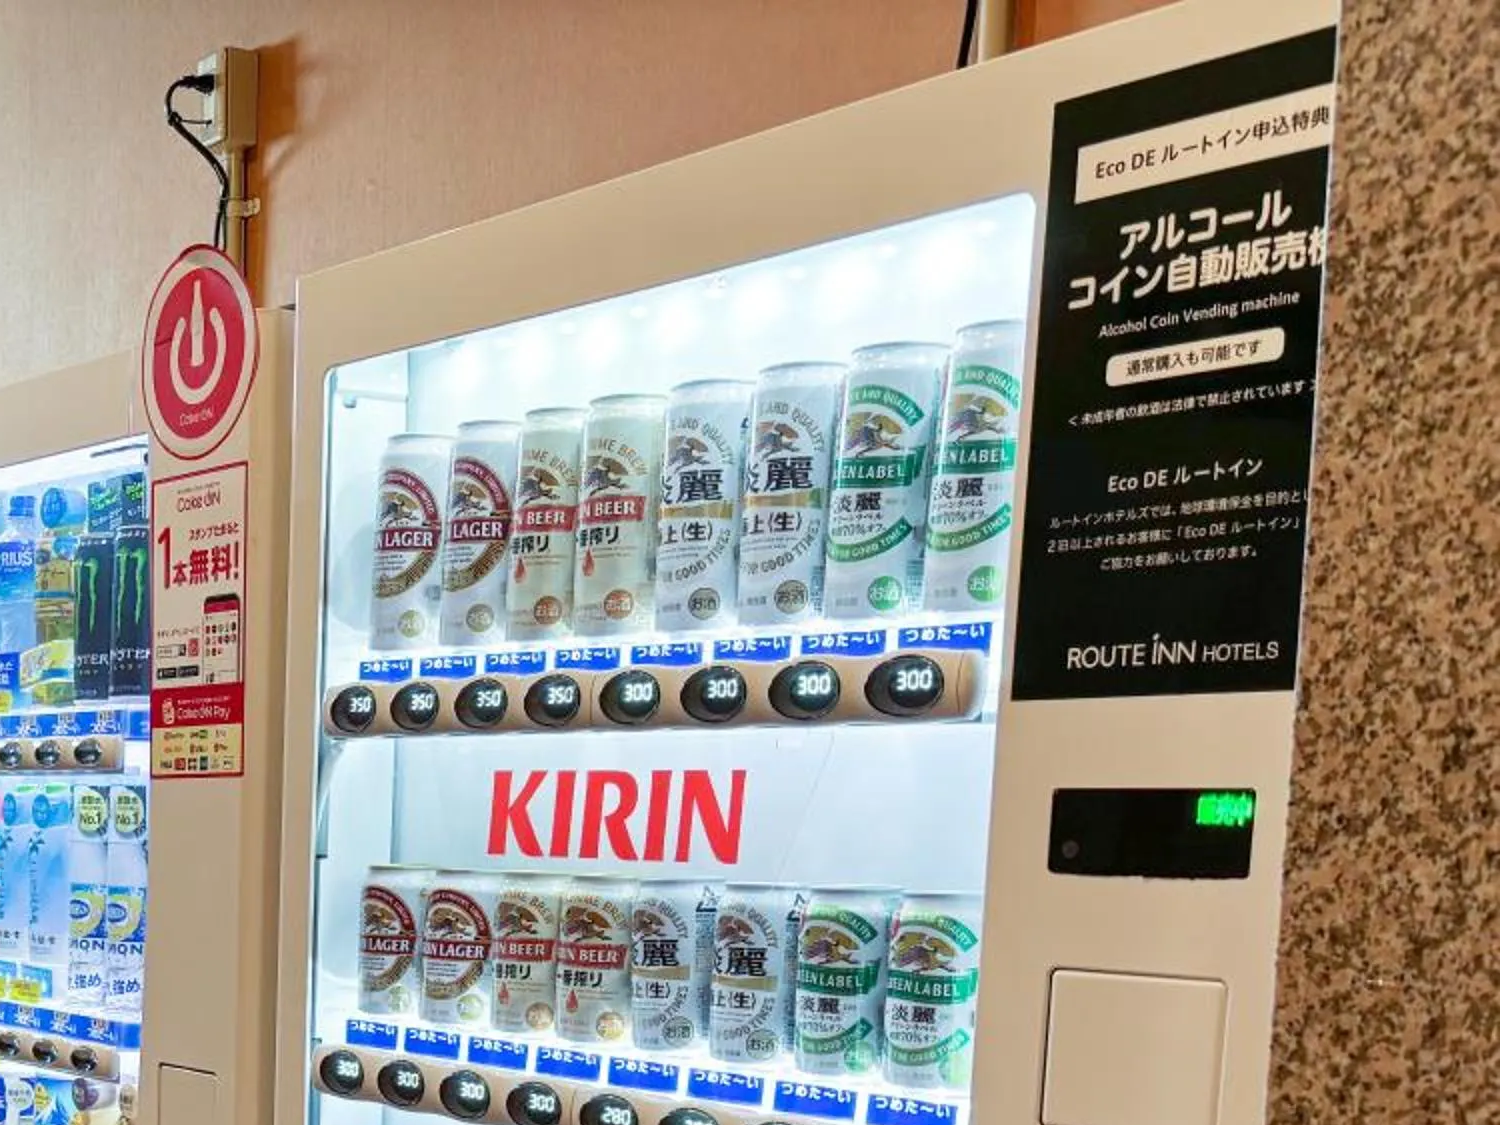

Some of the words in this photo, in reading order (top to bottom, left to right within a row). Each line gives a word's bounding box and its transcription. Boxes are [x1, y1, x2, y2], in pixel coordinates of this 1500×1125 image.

[1095, 161, 1125, 180] Eco
[1131, 150, 1156, 171] DE
[1161, 104, 1330, 163] ルートイン申込特典
[1120, 190, 1292, 260] アルコール
[1099, 316, 1148, 339] Alcohol
[1150, 310, 1180, 330] Coin
[1183, 302, 1238, 326] Vending
[1241, 290, 1300, 314] machine
[962, 448, 1008, 465] LABEL
[1108, 475, 1137, 493] Eco
[1144, 470, 1168, 487] DE
[1173, 458, 1263, 484] ルートイン
[934, 477, 984, 499] 淡麗
[595, 499, 637, 516] BEER
[527, 511, 565, 525] BEER
[453, 522, 503, 539] LAGER
[1210, 523, 1227, 536] DE
[386, 531, 433, 548] LAGER
[158, 527, 239, 589] 1本無料!
[1067, 644, 1146, 669] ROUTE
[1202, 642, 1279, 661] HOTELS
[625, 683, 653, 701] 300
[708, 678, 739, 698] 300
[797, 674, 831, 696] 300
[896, 668, 932, 691] 300
[80, 813, 102, 826] No.1
[487, 769, 747, 864] KIRIN
[369, 938, 409, 953] LAGER
[440, 943, 485, 959] LAGER
[509, 943, 546, 956] BEER
[579, 950, 618, 963] BEER
[819, 974, 864, 987] LABEL
[914, 980, 961, 997] LABEL
[892, 1004, 937, 1024] 淡麗
